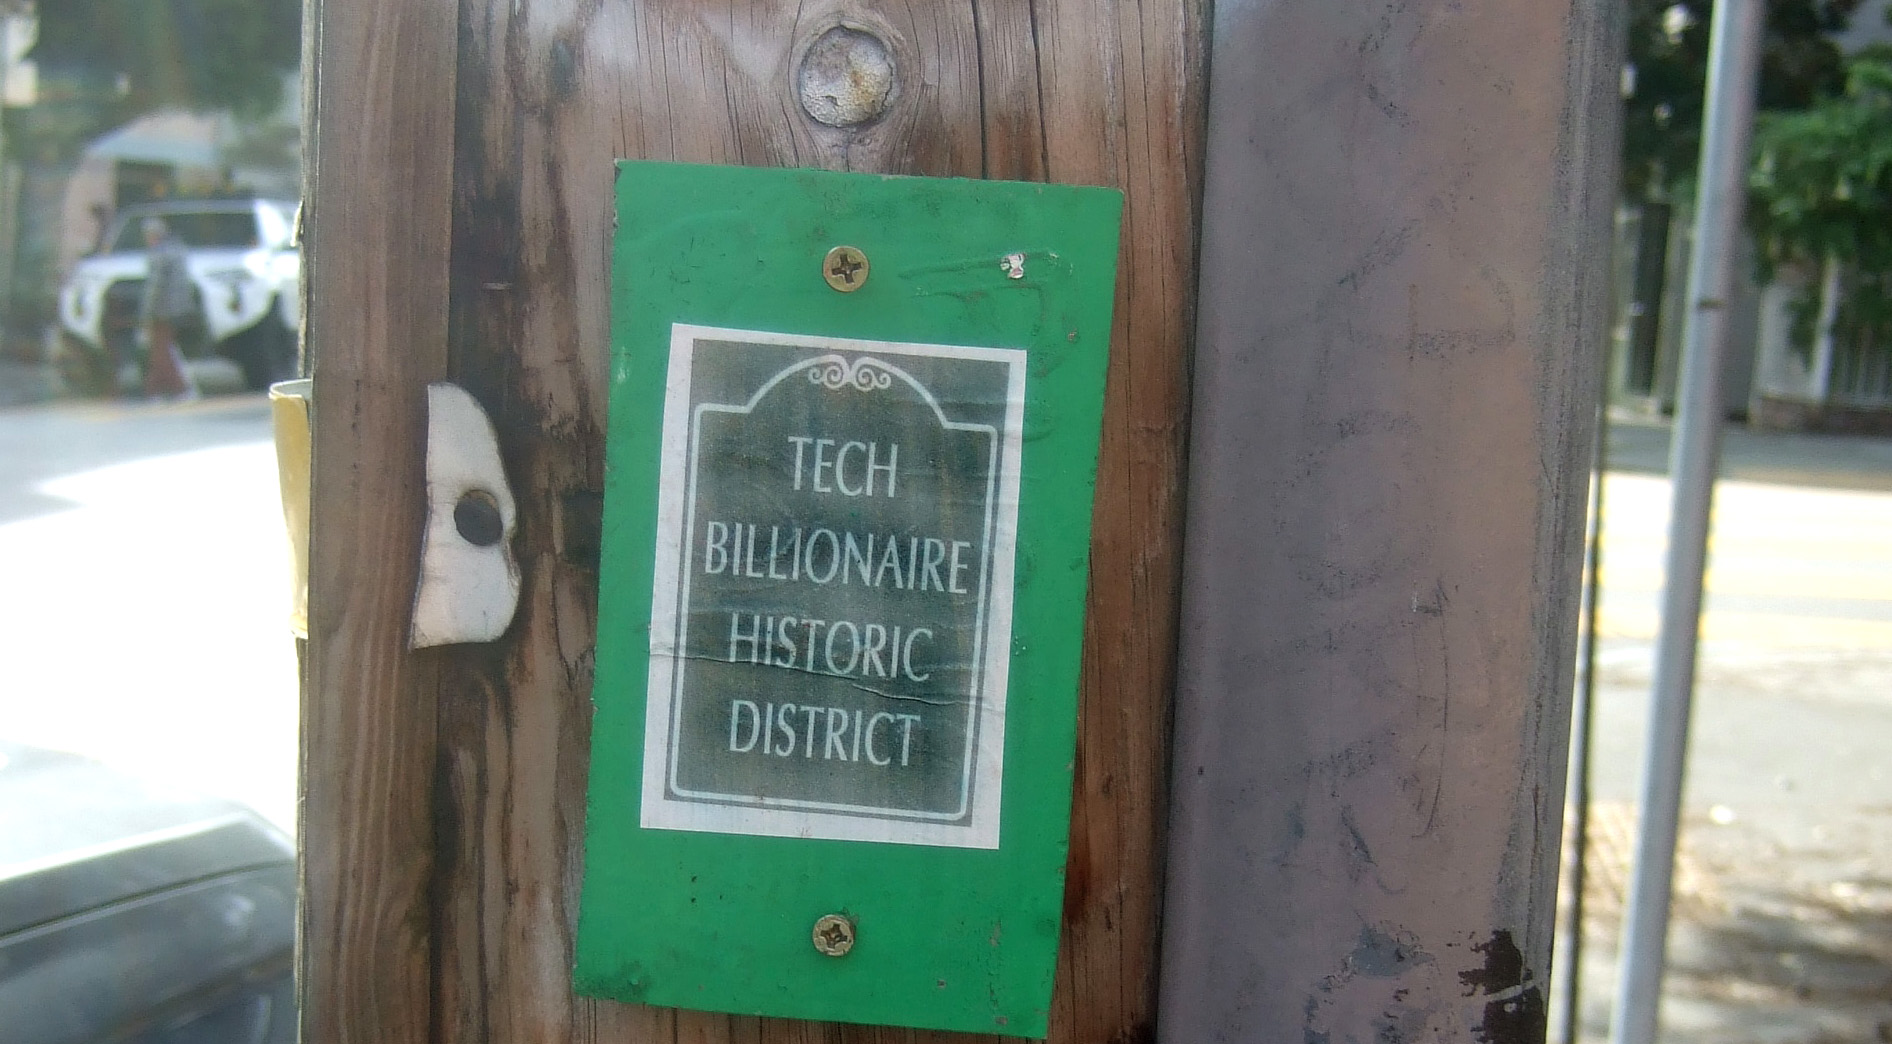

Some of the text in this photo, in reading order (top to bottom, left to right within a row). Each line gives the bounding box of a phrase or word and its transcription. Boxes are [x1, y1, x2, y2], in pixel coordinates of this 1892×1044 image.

[787, 435, 898, 498] TECH
[704, 520, 971, 594] BILLIONAIRE
[728, 612, 933, 682] HISTORIC
[729, 699, 922, 767] DISTRICT
